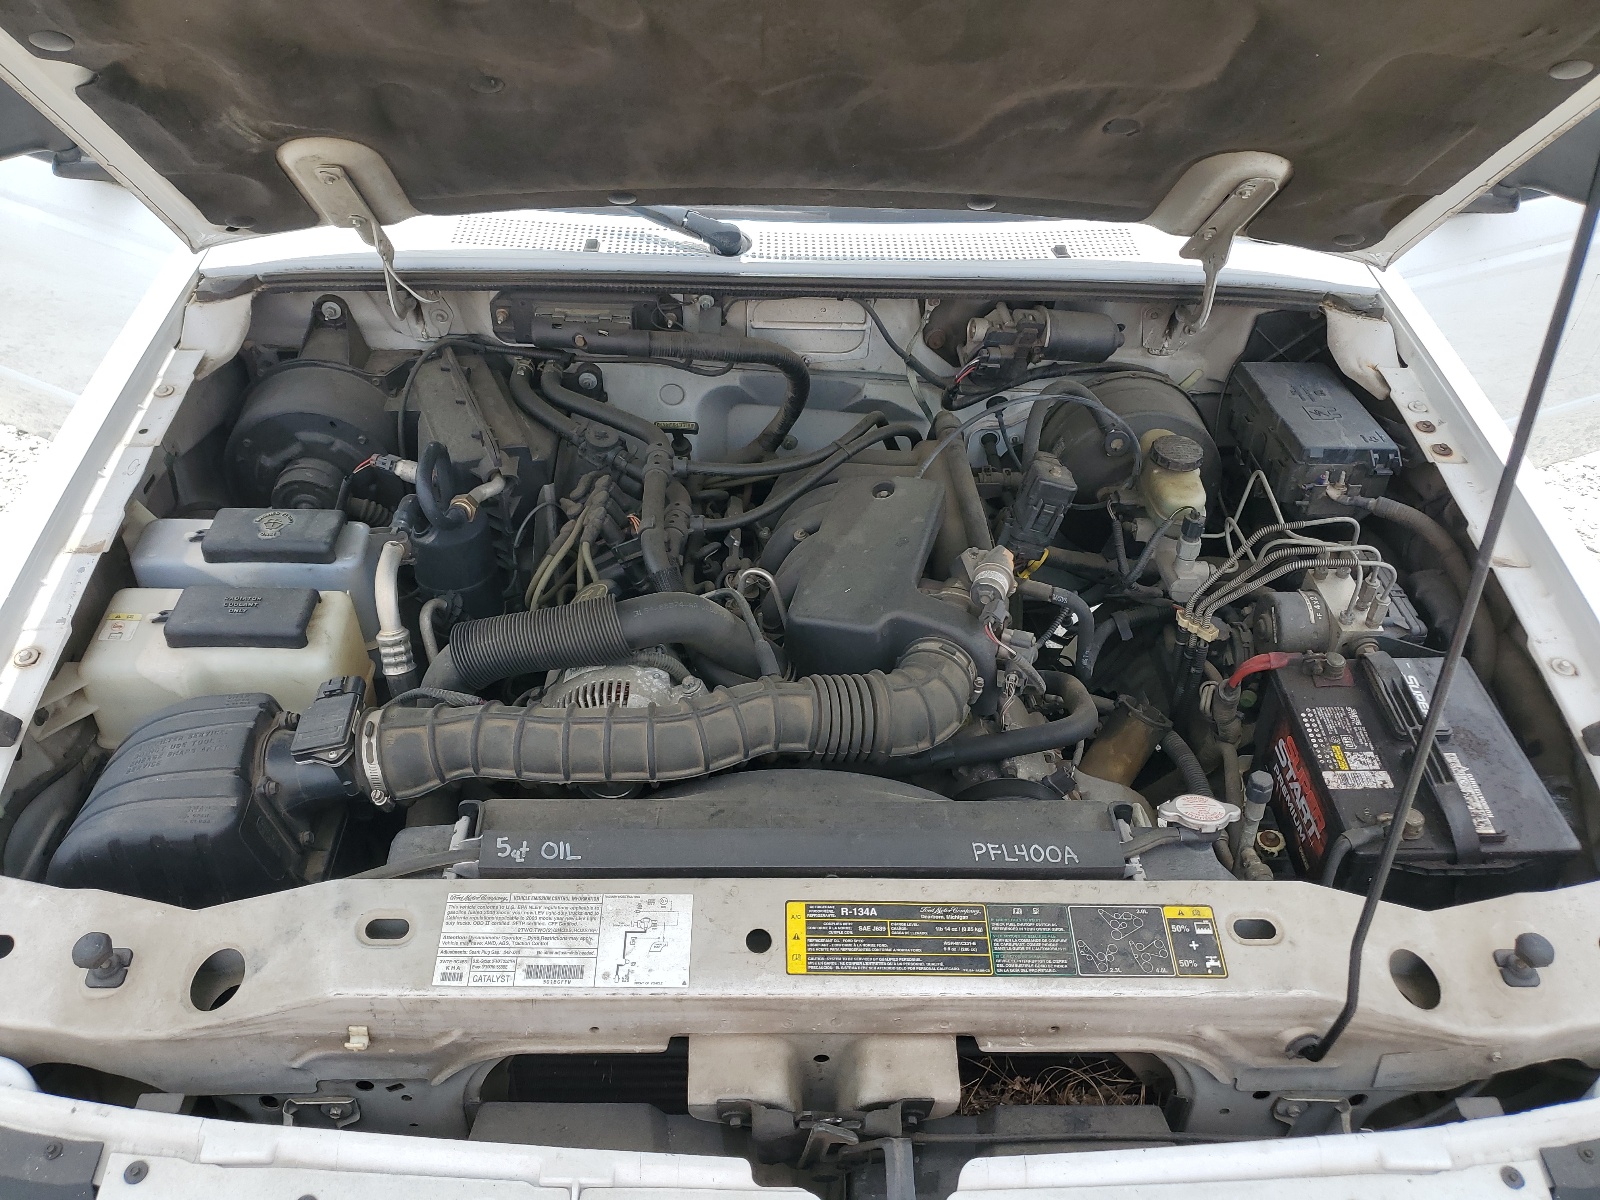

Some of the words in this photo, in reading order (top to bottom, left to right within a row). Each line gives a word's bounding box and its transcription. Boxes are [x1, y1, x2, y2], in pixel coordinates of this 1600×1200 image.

[1402, 674, 1431, 719] SUPE
[1274, 738, 1321, 841] START
[1286, 735, 1326, 833] SUPER
[1273, 763, 1306, 843] PREMIUM
[540, 841, 582, 860] OIL
[971, 841, 1080, 865] PFL400A
[840, 907, 878, 916] R-134A
[1171, 924, 1190, 933] 50%
[1178, 959, 1198, 968] 50%
[472, 974, 511, 983] CATALYST
